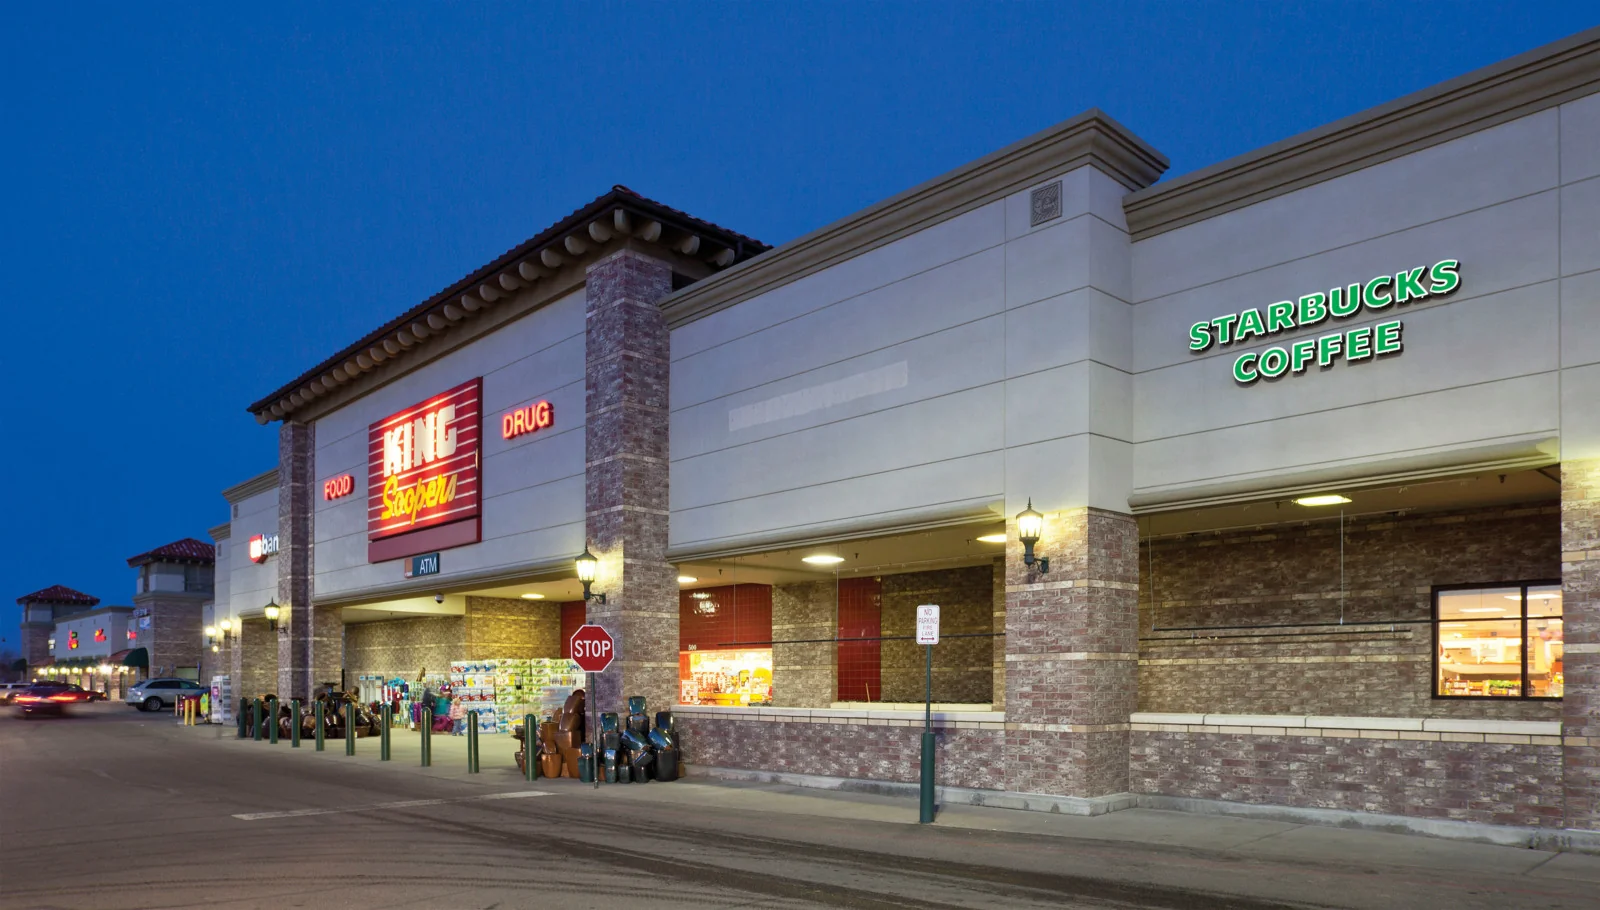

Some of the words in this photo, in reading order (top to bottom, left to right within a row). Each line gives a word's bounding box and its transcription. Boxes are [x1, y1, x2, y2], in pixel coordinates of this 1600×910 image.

[1188, 258, 1460, 352] STARBUCKS
[1232, 319, 1402, 383] COFFEE
[502, 400, 550, 440] DRUG
[383, 403, 457, 478] KING
[324, 475, 351, 501] FOOD
[381, 473, 458, 526] Soopers
[262, 533, 279, 555] ban
[420, 556, 438, 575] ATM
[918, 617, 938, 625] PARKING
[924, 608, 933, 616] NO
[574, 640, 611, 658] STOP
